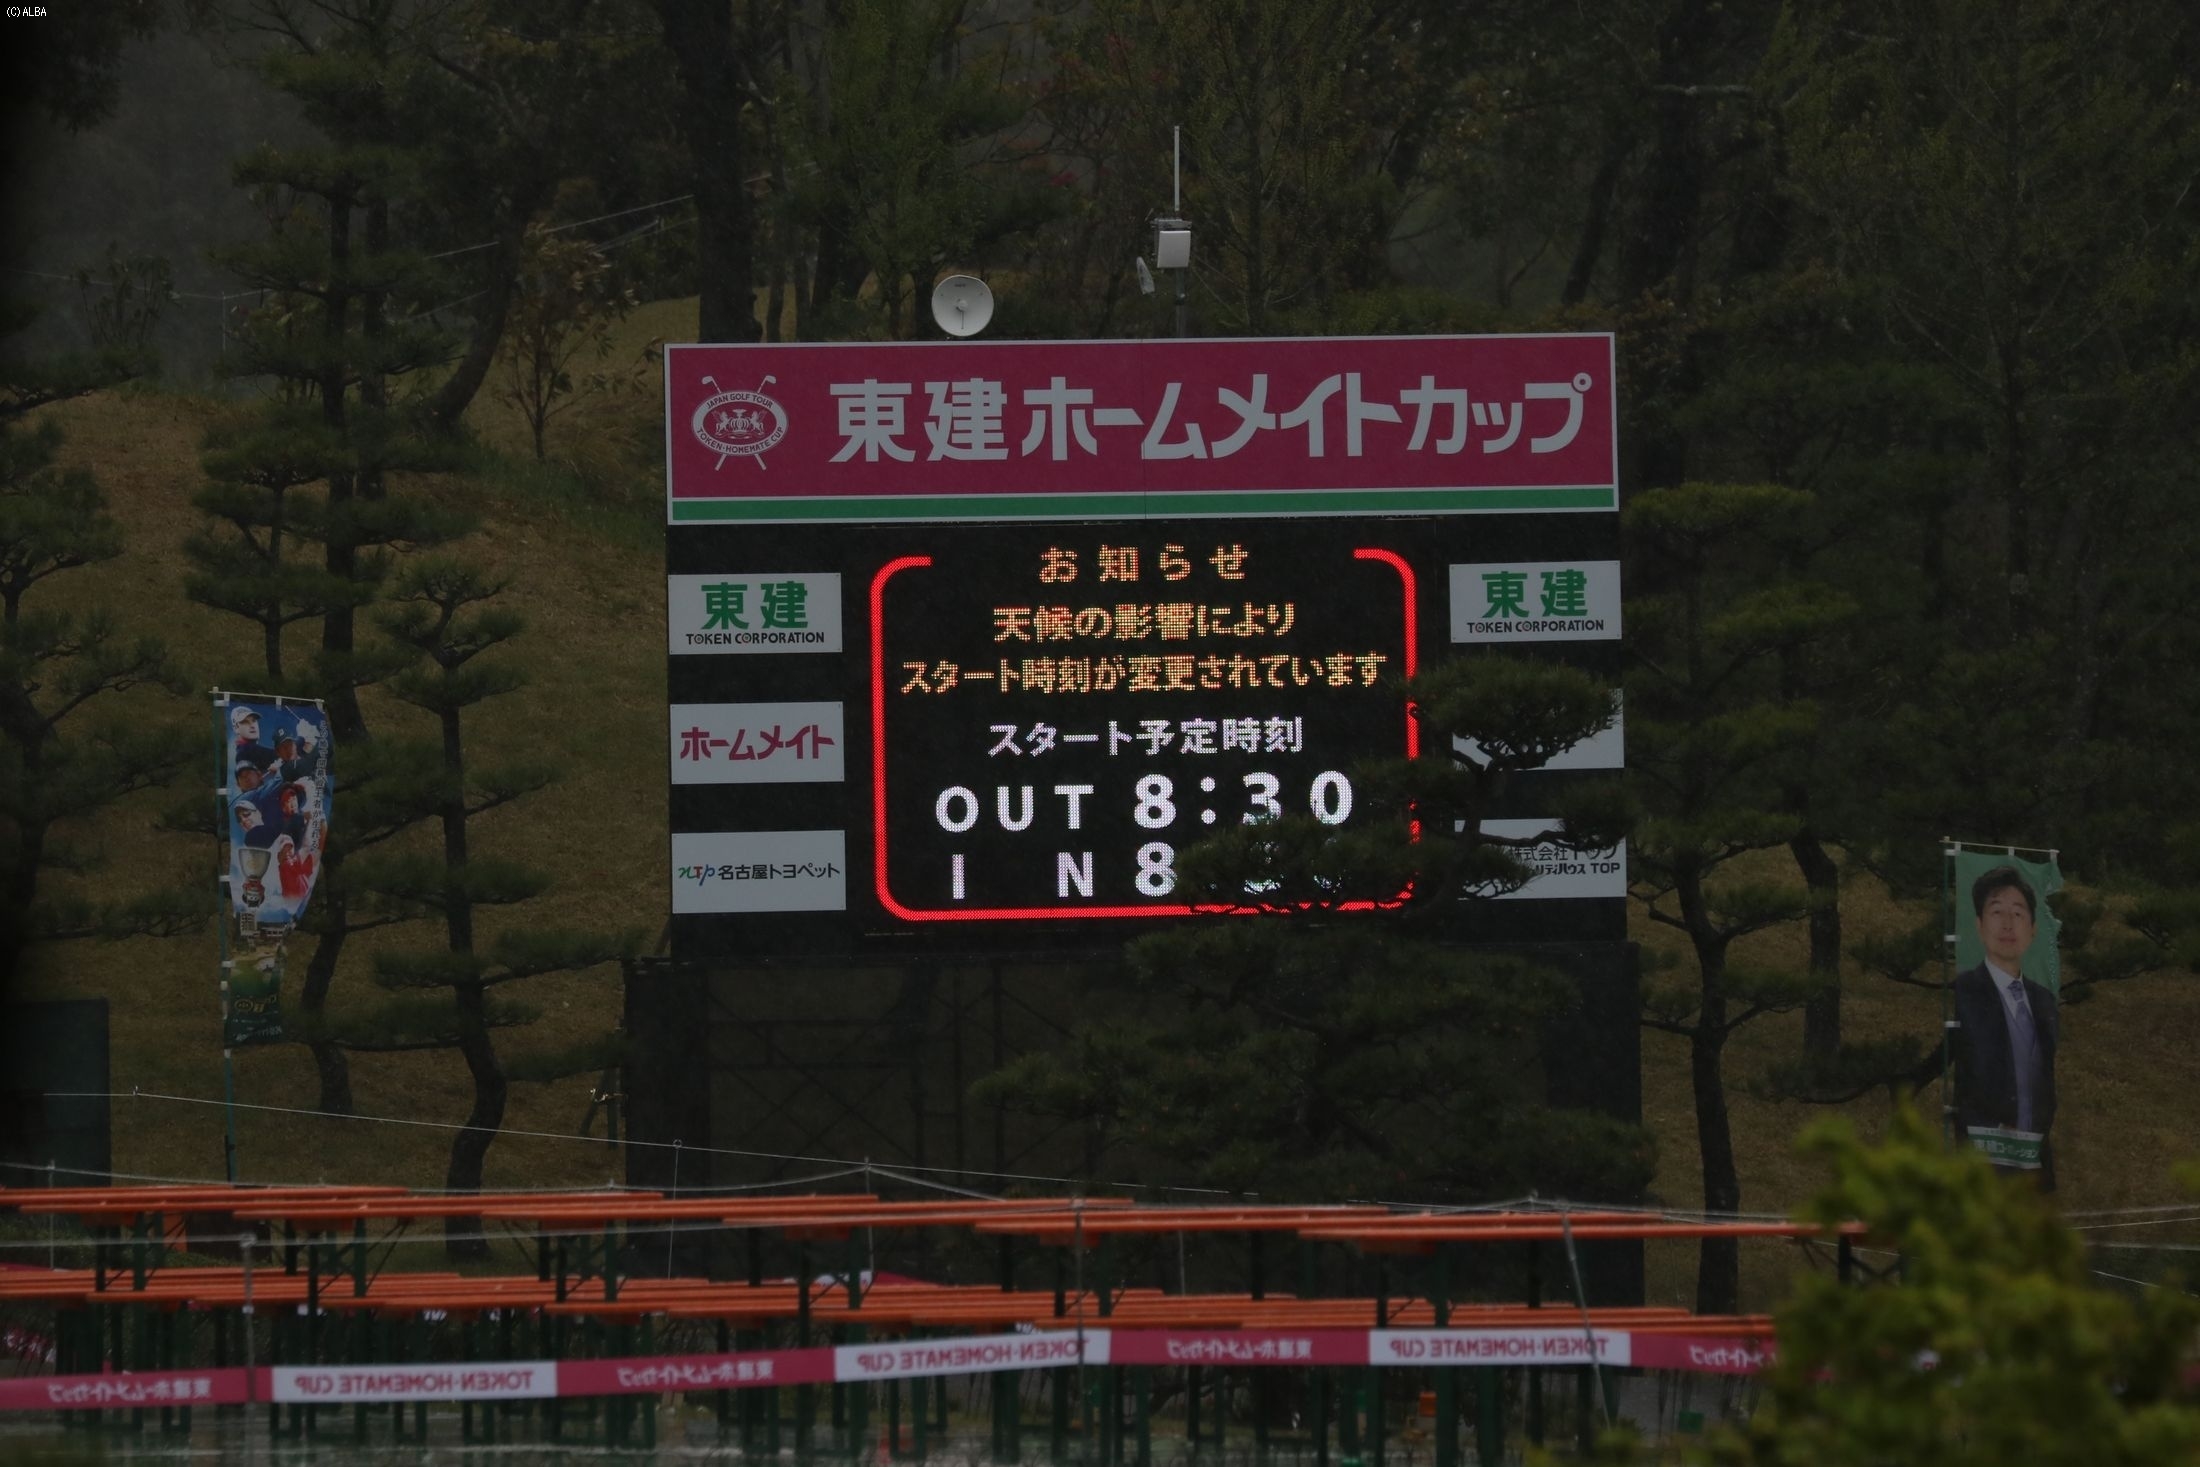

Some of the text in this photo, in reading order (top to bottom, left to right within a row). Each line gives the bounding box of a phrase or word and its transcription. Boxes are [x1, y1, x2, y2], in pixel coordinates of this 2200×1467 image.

[707, 393, 774, 409] JAPAN GOLF TOUR
[829, 372, 1592, 463] 東建ホームメイトカップ
[770, 426, 785, 442] CUP
[1039, 543, 1248, 584] お知らせ
[700, 580, 809, 630] 東建
[1481, 568, 1588, 619] 東建
[685, 631, 825, 645] TOKEN CORPORATION
[993, 601, 1295, 643] 天候の影響により
[1466, 619, 1604, 634] TOKEN CORPORATION
[900, 650, 1388, 694] スタート時刻が変更されています
[680, 724, 835, 761] ホームメイト
[987, 716, 1303, 758] スタート予定時刻
[935, 770, 1353, 833] OUT 8:30
[717, 862, 840, 880] 名古屋トヨペット
[1590, 862, 1620, 874] TOP
